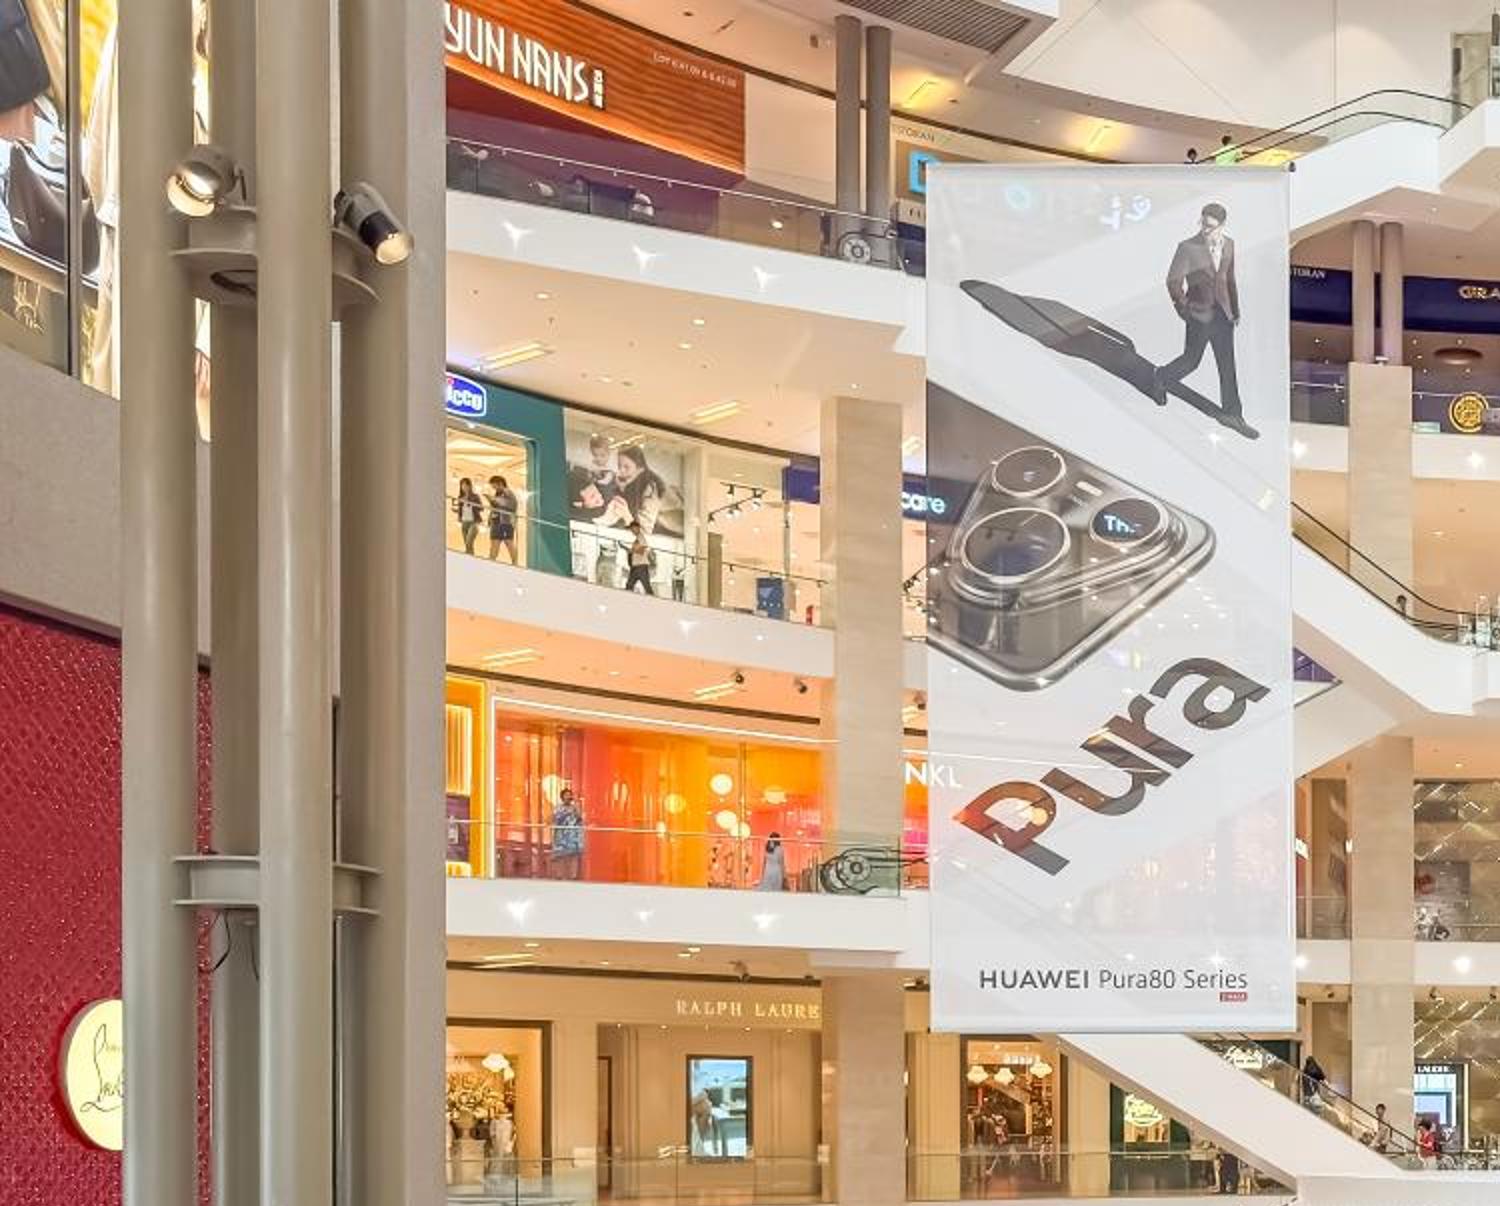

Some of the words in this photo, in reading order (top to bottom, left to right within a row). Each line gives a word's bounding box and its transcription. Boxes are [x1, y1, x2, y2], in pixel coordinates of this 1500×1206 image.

[513, 33, 590, 102] NANS
[952, 656, 1272, 876] Pura
[979, 969, 1090, 989] HUAWEI
[1098, 968, 1177, 990] Pura80
[1183, 968, 1248, 989] Series
[676, 999, 742, 1017] RALPH
